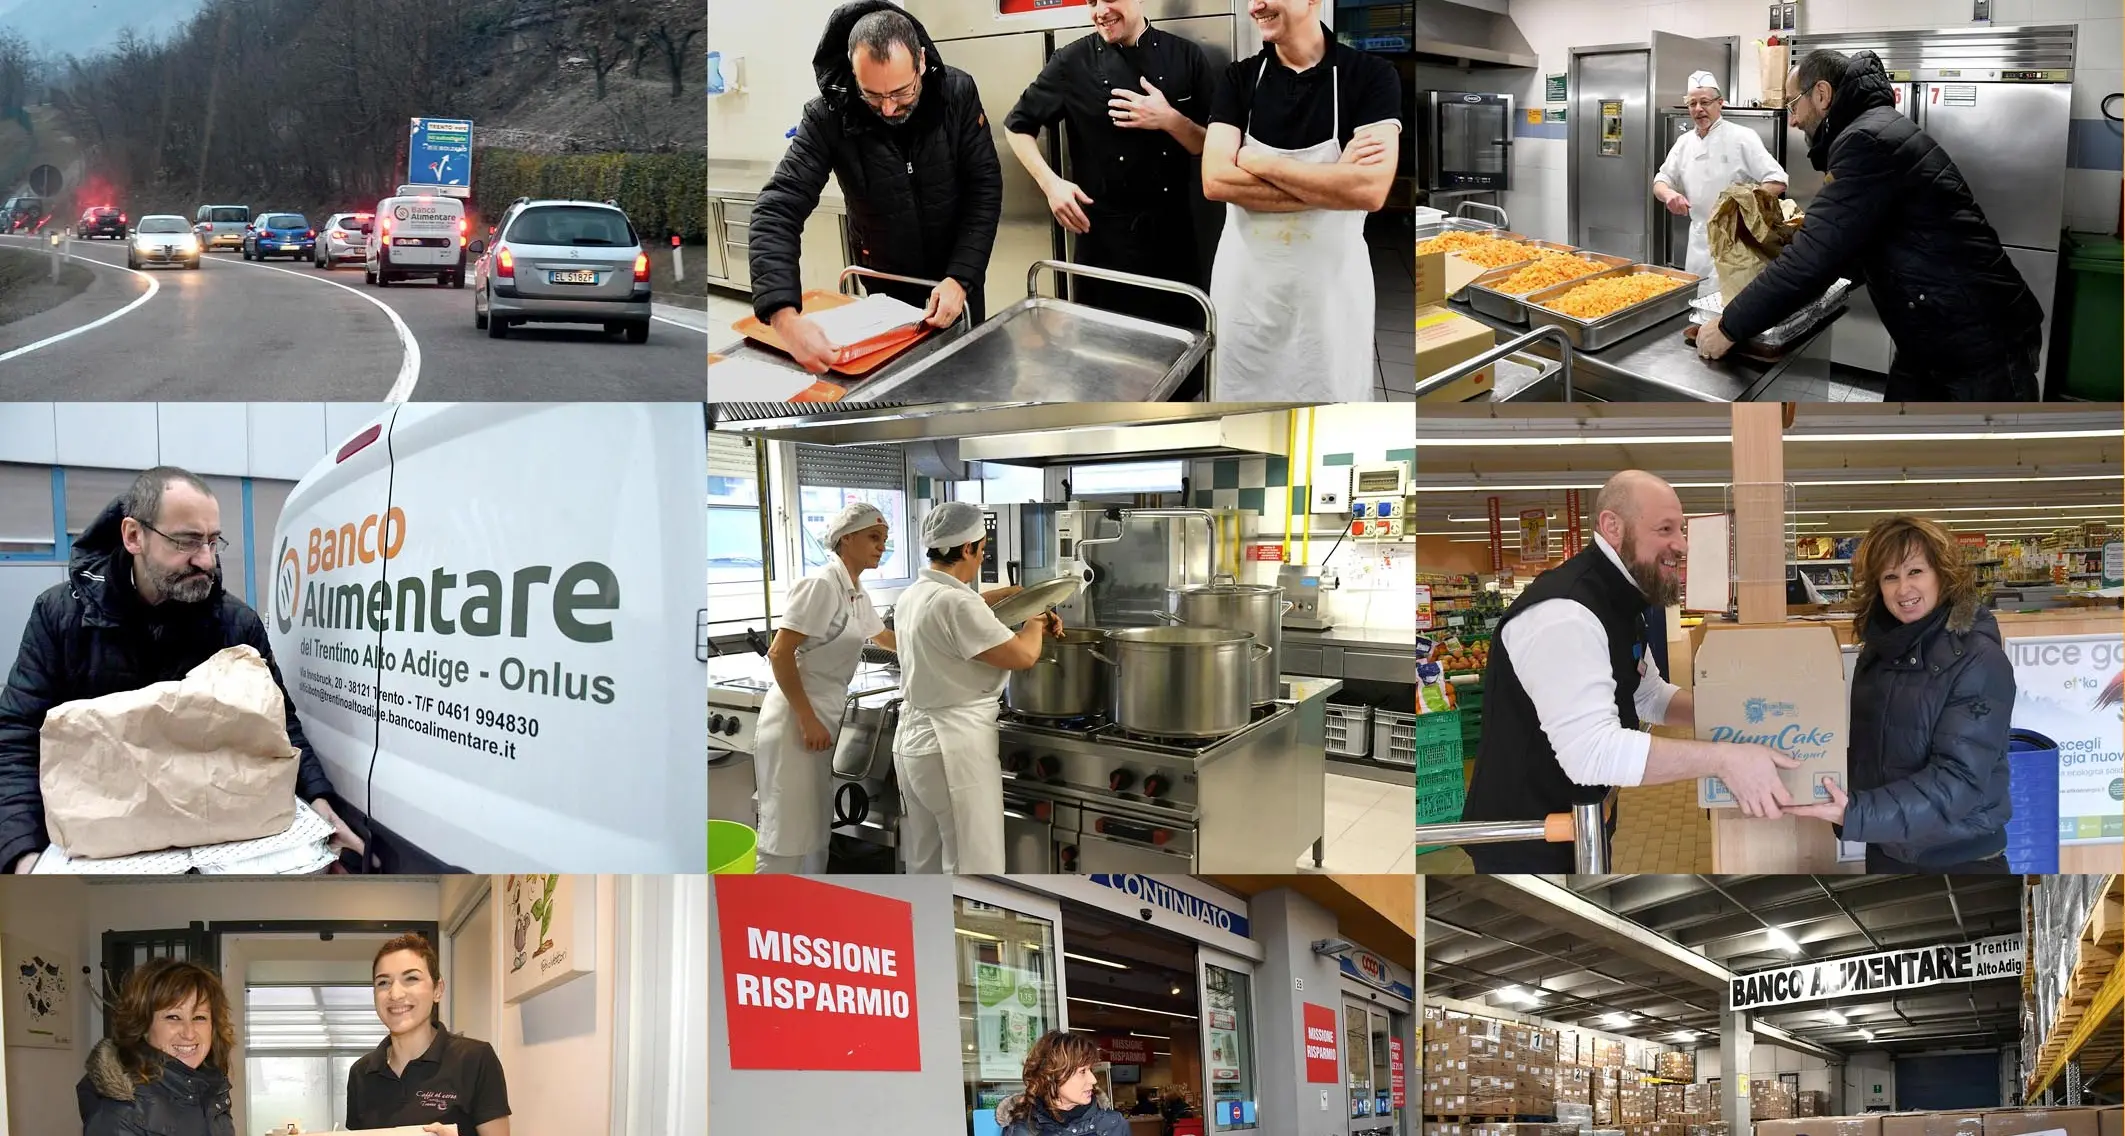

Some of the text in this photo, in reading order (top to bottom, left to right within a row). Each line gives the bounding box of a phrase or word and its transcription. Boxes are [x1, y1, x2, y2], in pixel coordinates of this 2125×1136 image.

[1931, 88, 1940, 104] 7
[411, 206, 436, 214] Banco
[411, 213, 456, 221] Alimentare
[555, 273, 564, 281] EL
[307, 506, 406, 575] Banco
[301, 560, 620, 642] Alimentare
[2014, 644, 2082, 667] luce
[300, 638, 312, 656] del
[314, 638, 359, 665] Trentino
[362, 644, 397, 672] Alto
[400, 647, 469, 688] Adige
[499, 657, 616, 705] Onlus
[334, 676, 343, 690] 20
[348, 680, 370, 698] 38121
[372, 686, 405, 706] Trento
[415, 695, 435, 713] T/F
[437, 700, 470, 722] 0461
[476, 708, 539, 738] 994830
[2059, 737, 2102, 753] scegli
[1108, 873, 1231, 932] CONTINUATO
[747, 926, 898, 977] MISSIONE
[1732, 945, 1973, 1007] BANCO AIMENTARE
[1976, 958, 2024, 977] AltoAdig
[736, 973, 910, 1019] RISPARMIO
[1307, 1026, 1334, 1043] MISSIONE
[1534, 1034, 1540, 1047] 1
[1112, 1038, 1144, 1051] MISSIONE
[1306, 1045, 1337, 1061] RISPARMIO
[1110, 1051, 1147, 1063] RISPARMIO
